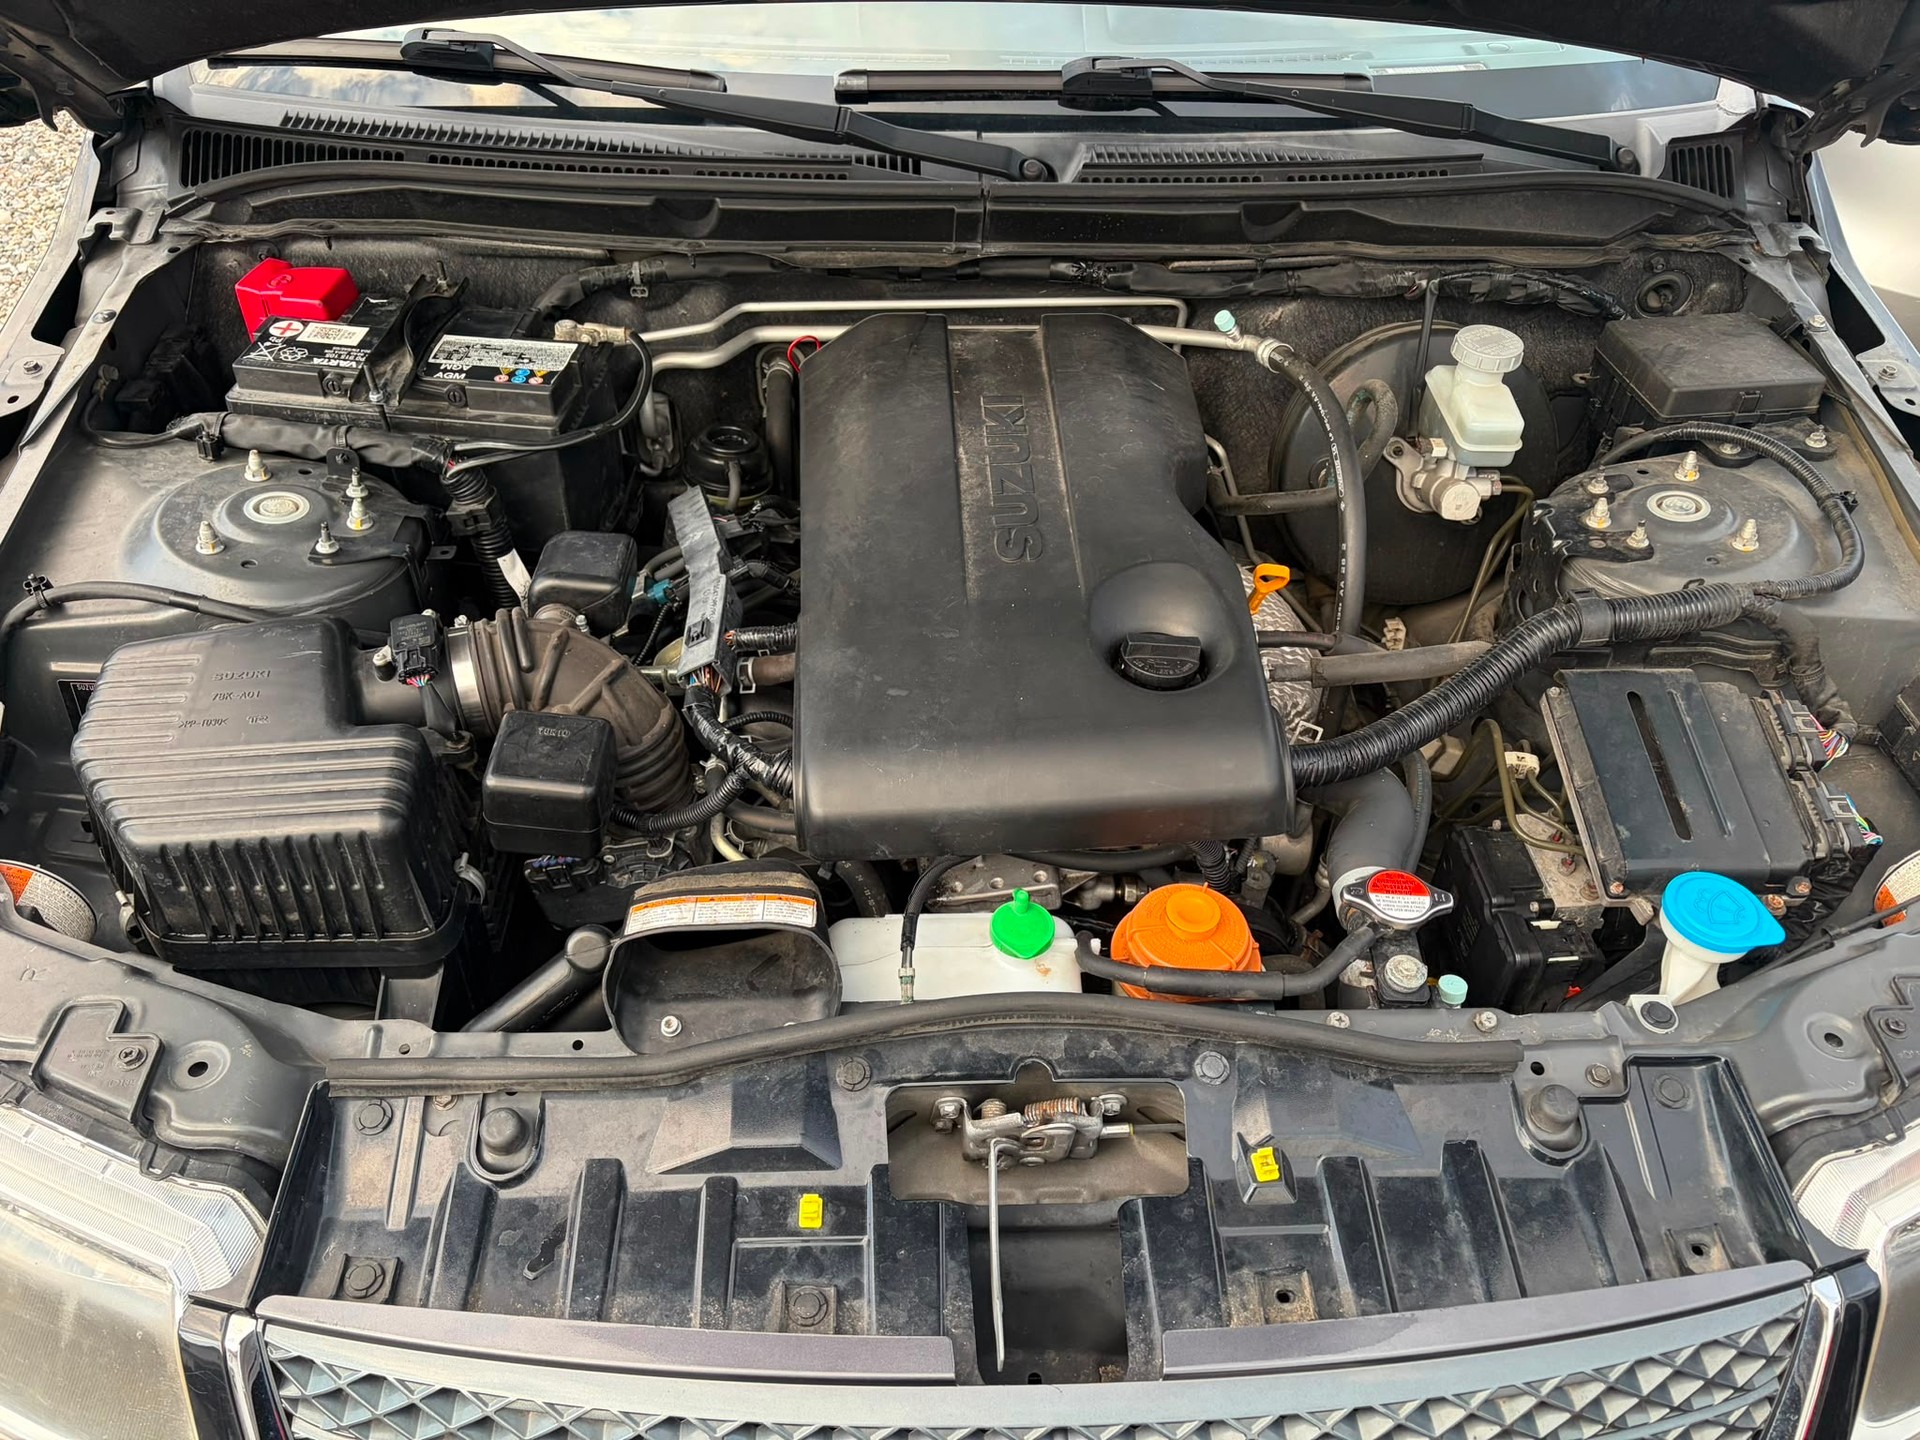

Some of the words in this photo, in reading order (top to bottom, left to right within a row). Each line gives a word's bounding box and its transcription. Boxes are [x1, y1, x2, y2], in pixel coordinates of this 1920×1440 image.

[312, 357, 357, 368] VARTA
[433, 371, 467, 380] AGM
[980, 395, 1043, 563] SUZUKI
[211, 669, 271, 681] SUZUKI
